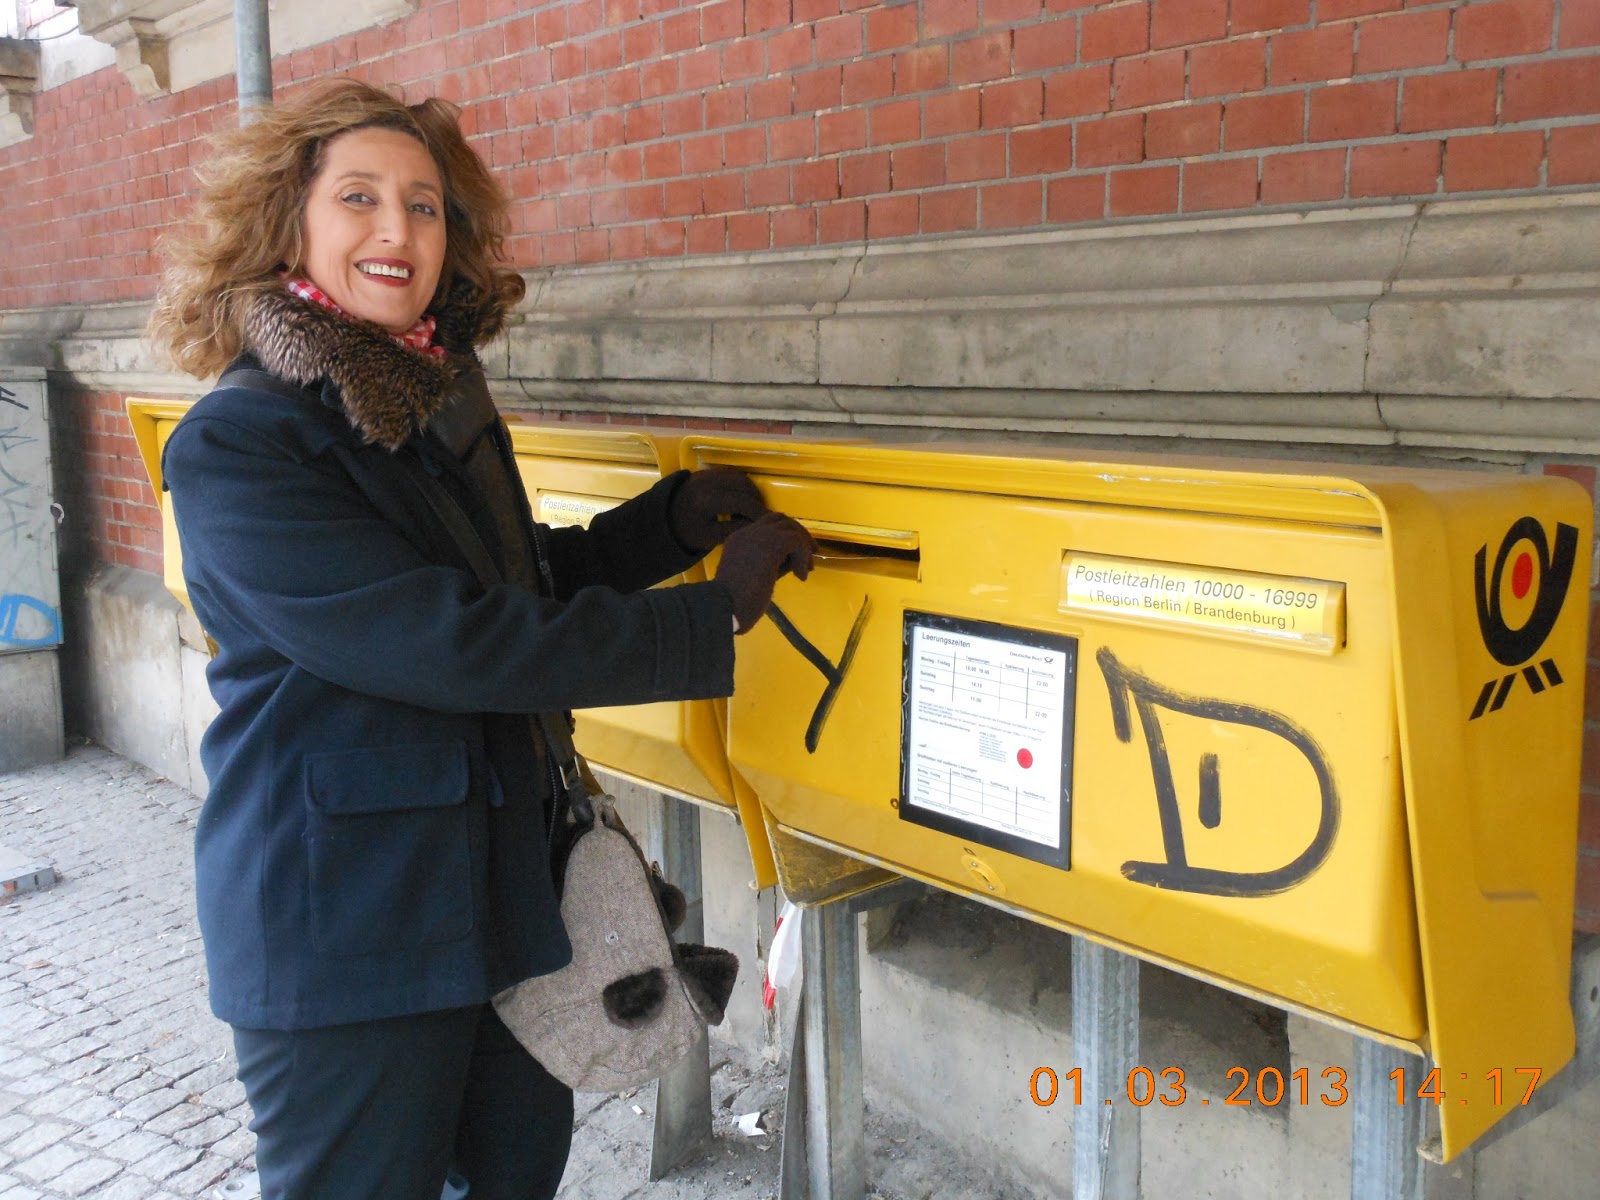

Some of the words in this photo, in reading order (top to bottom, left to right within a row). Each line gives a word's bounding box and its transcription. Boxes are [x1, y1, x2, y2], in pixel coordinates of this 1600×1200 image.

[1075, 565, 1186, 593] Postleitzahlen
[1194, 579, 1245, 600] 10000
[1264, 588, 1318, 609] 16999
[1096, 590, 1140, 607] Region
[1144, 596, 1182, 612] Berlin
[1194, 602, 1287, 630] Brandenburg
[922, 632, 971, 648] Leerungszeiten
[1010, 651, 1031, 660] Deutsche
